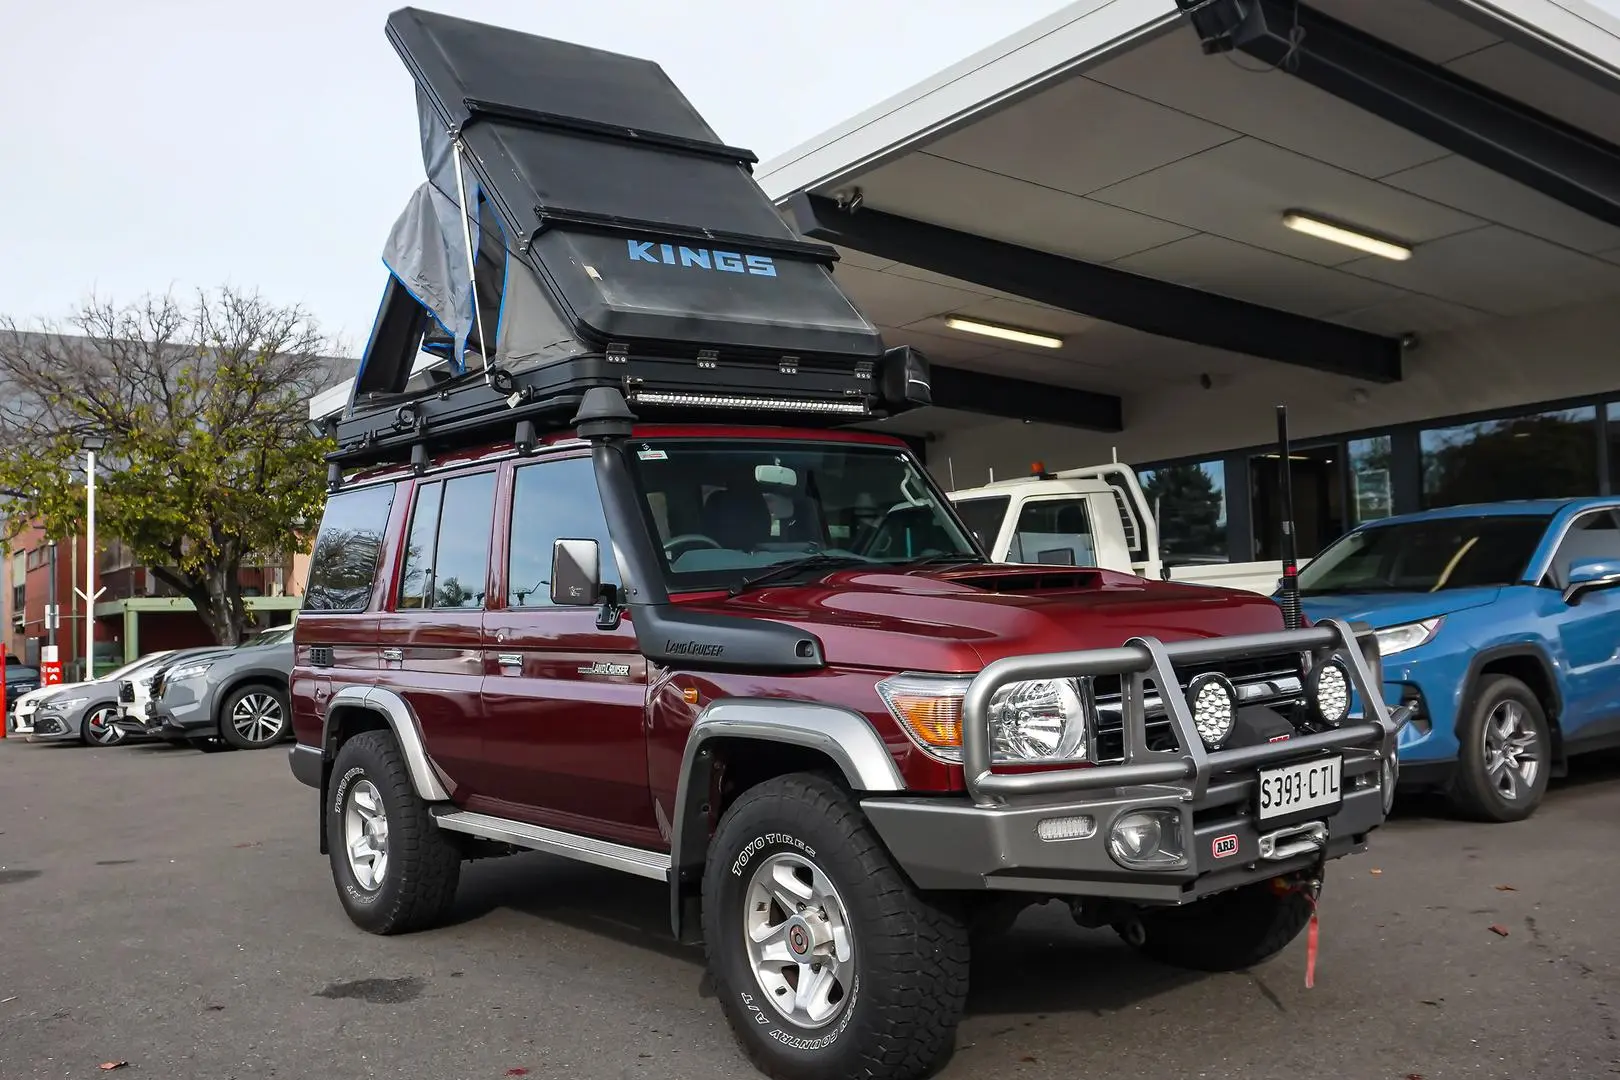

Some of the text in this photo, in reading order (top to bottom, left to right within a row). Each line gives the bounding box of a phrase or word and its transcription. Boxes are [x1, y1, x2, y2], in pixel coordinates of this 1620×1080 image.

[627, 239, 777, 277] KINGS
[732, 833, 817, 876] TOYO TIRES
[1216, 839, 1235, 853] ARB
[741, 992, 770, 1025] A/T
[769, 1027, 839, 1050] COUNTRY
